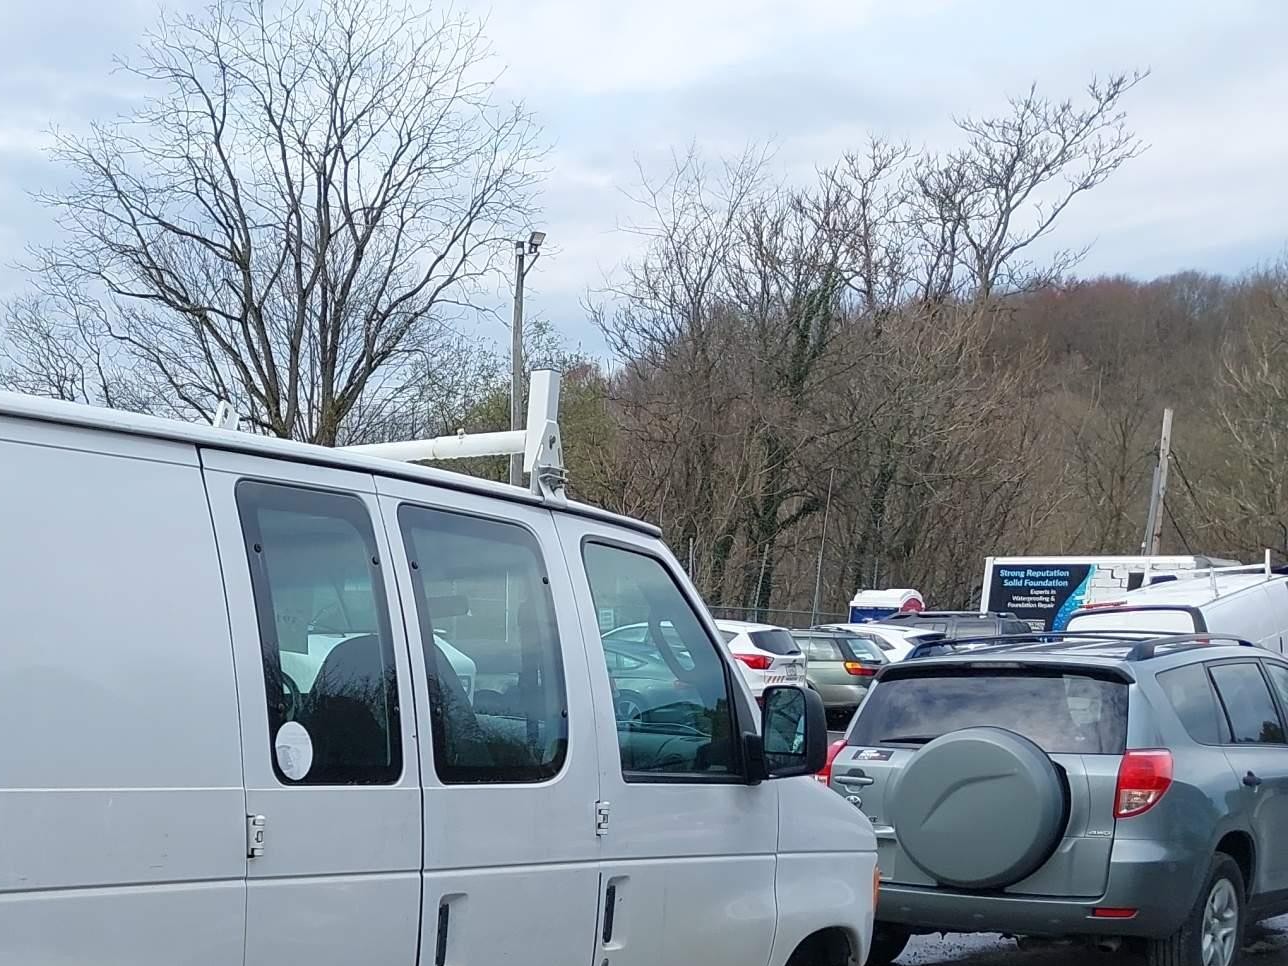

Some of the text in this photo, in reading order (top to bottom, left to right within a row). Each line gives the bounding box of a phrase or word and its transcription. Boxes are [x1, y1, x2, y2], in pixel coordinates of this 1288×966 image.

[1000, 569, 1070, 578] Strong Reputation
[1003, 579, 1069, 587] Solid Foundation
